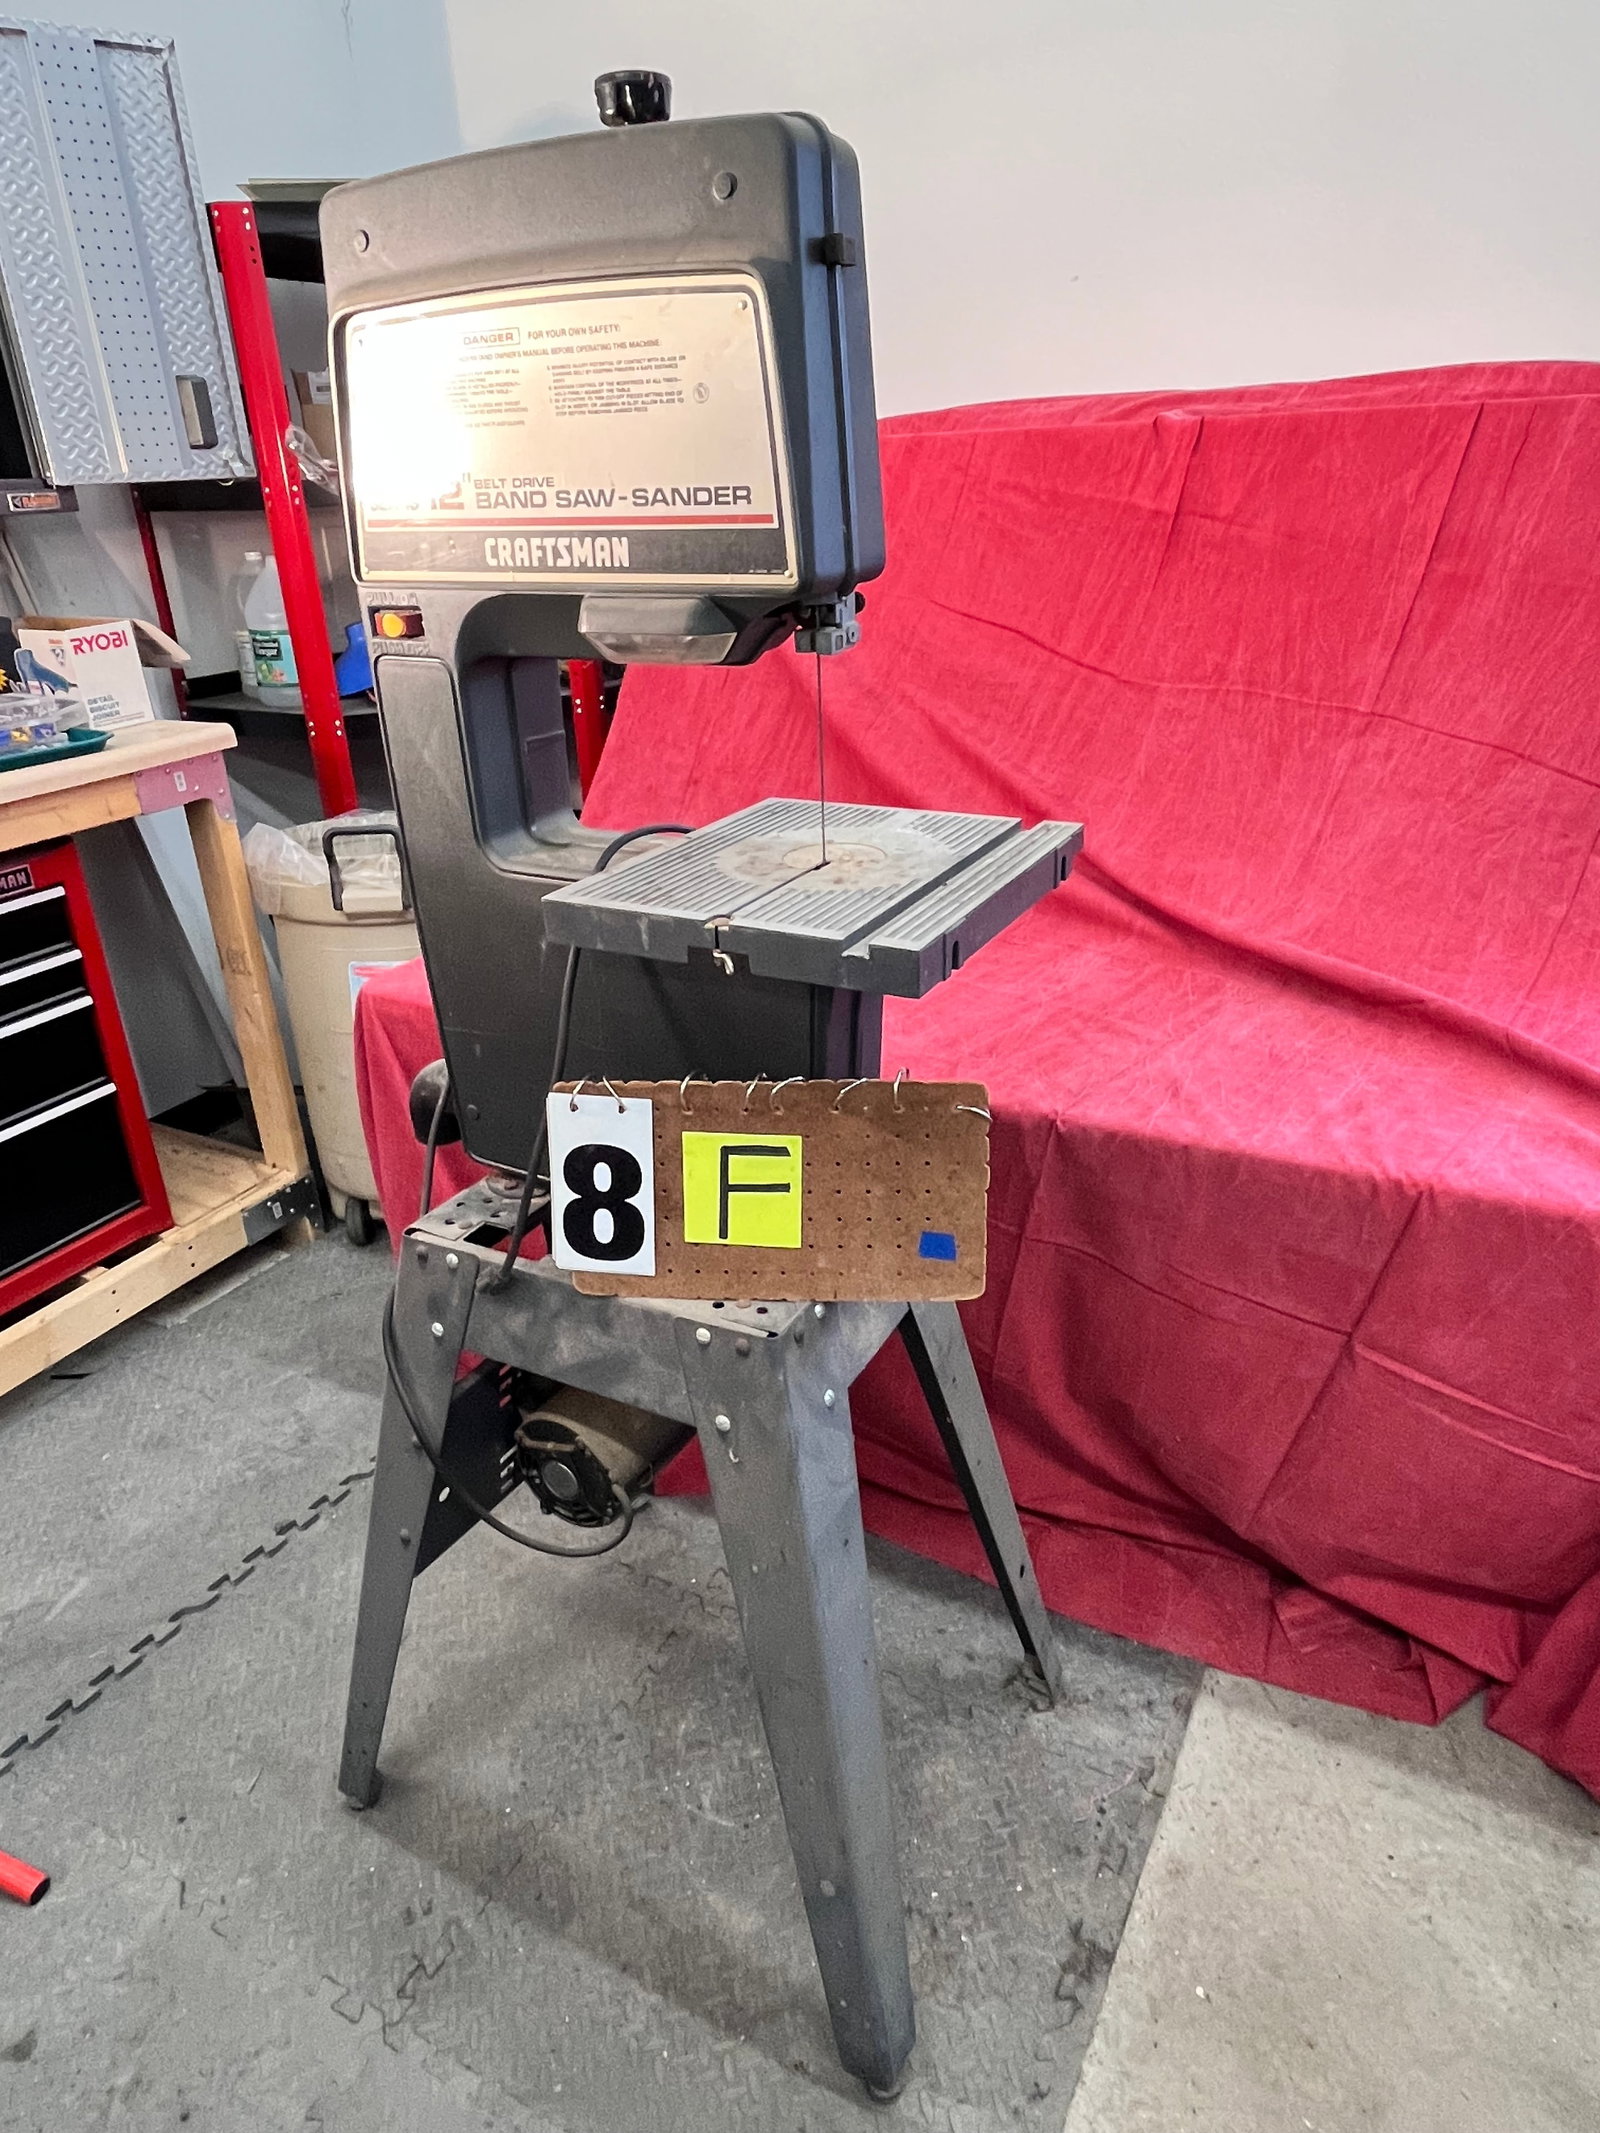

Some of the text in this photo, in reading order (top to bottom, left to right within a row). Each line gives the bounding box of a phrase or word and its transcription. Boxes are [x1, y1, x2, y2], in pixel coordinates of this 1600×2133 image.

[463, 332, 514, 346] DANGER
[527, 330, 544, 340] FOR
[545, 328, 567, 339] YOUR
[568, 326, 587, 337] OWN
[522, 347, 550, 357] MANUAL
[550, 345, 575, 355] BEFORE
[575, 342, 612, 353] OPERATING
[612, 341, 627, 350] THIS
[474, 478, 508, 490] BELT
[512, 476, 555, 488] DRIVE
[475, 489, 547, 510] BAND
[484, 536, 630, 567] CRAFTSMAN
[70, 629, 129, 655] RYOBI
[562, 1143, 645, 1261] 8
[719, 1145, 792, 1240] F
